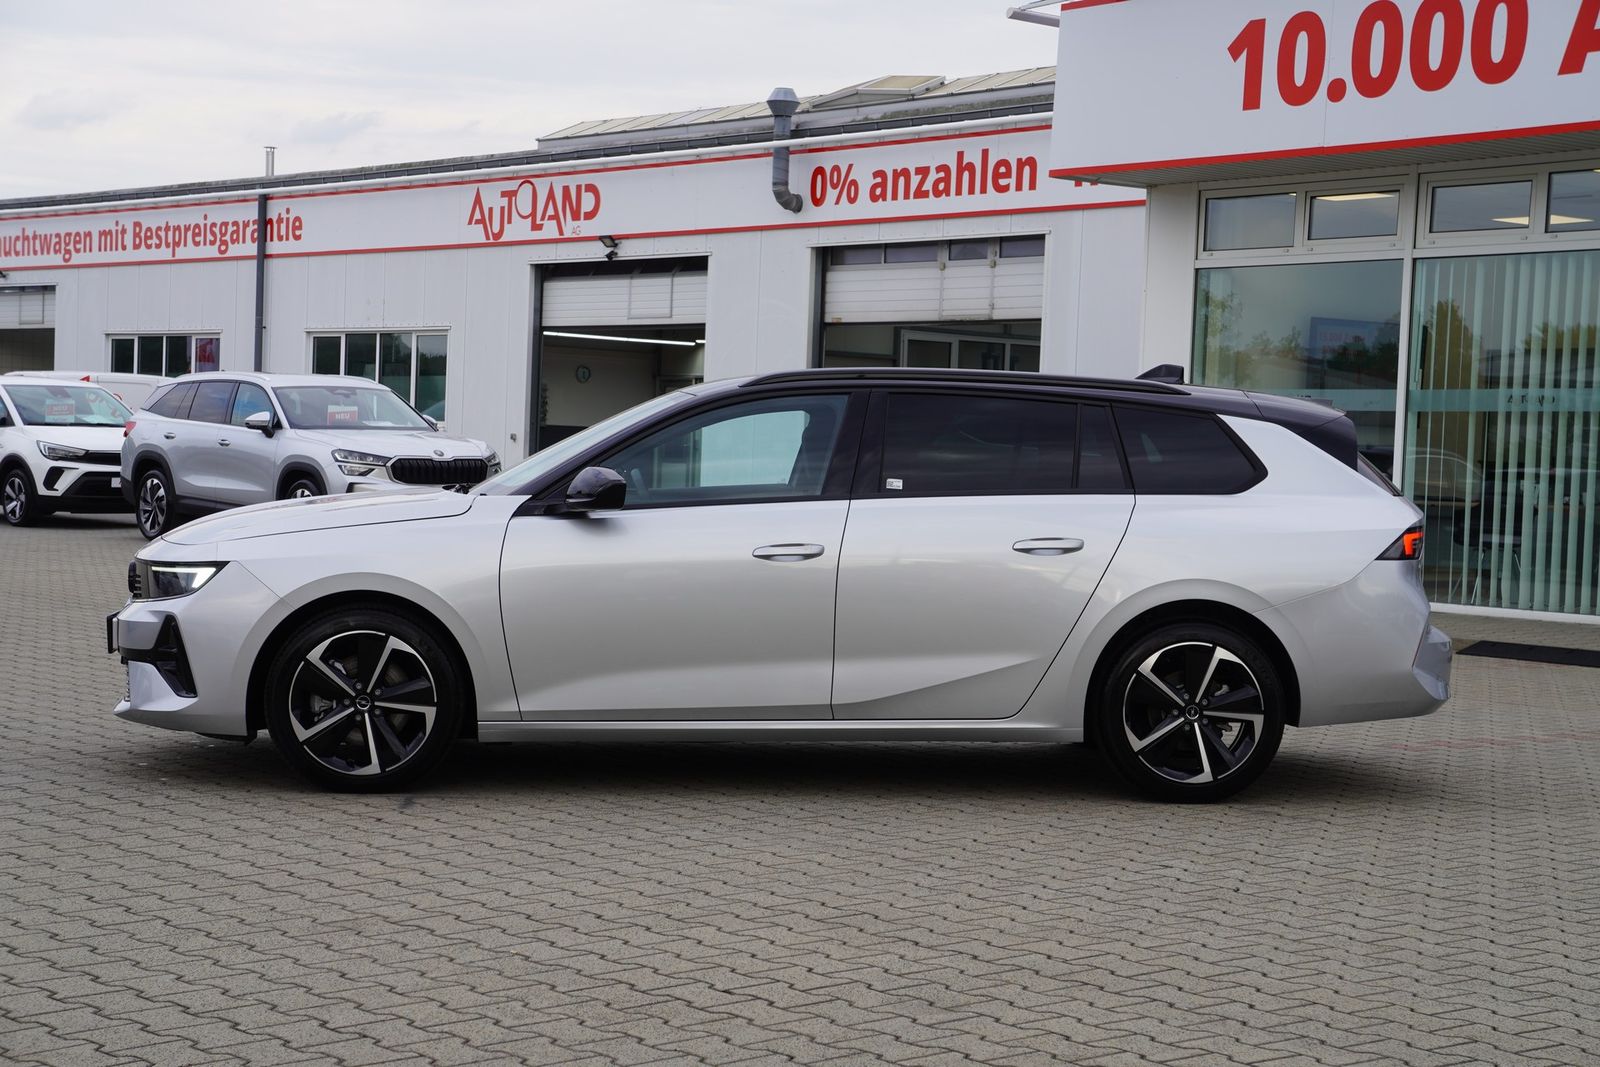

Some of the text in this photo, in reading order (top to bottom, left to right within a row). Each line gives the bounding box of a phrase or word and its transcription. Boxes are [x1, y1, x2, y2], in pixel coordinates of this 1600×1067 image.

[1227, 0, 1529, 112] 10.000
[810, 148, 1038, 208] 0% anzahlen
[98, 220, 127, 252] mit
[132, 207, 304, 258] Bestpreisgarantie
[467, 179, 602, 242] AUTOLAND
[571, 225, 582, 236] AG
